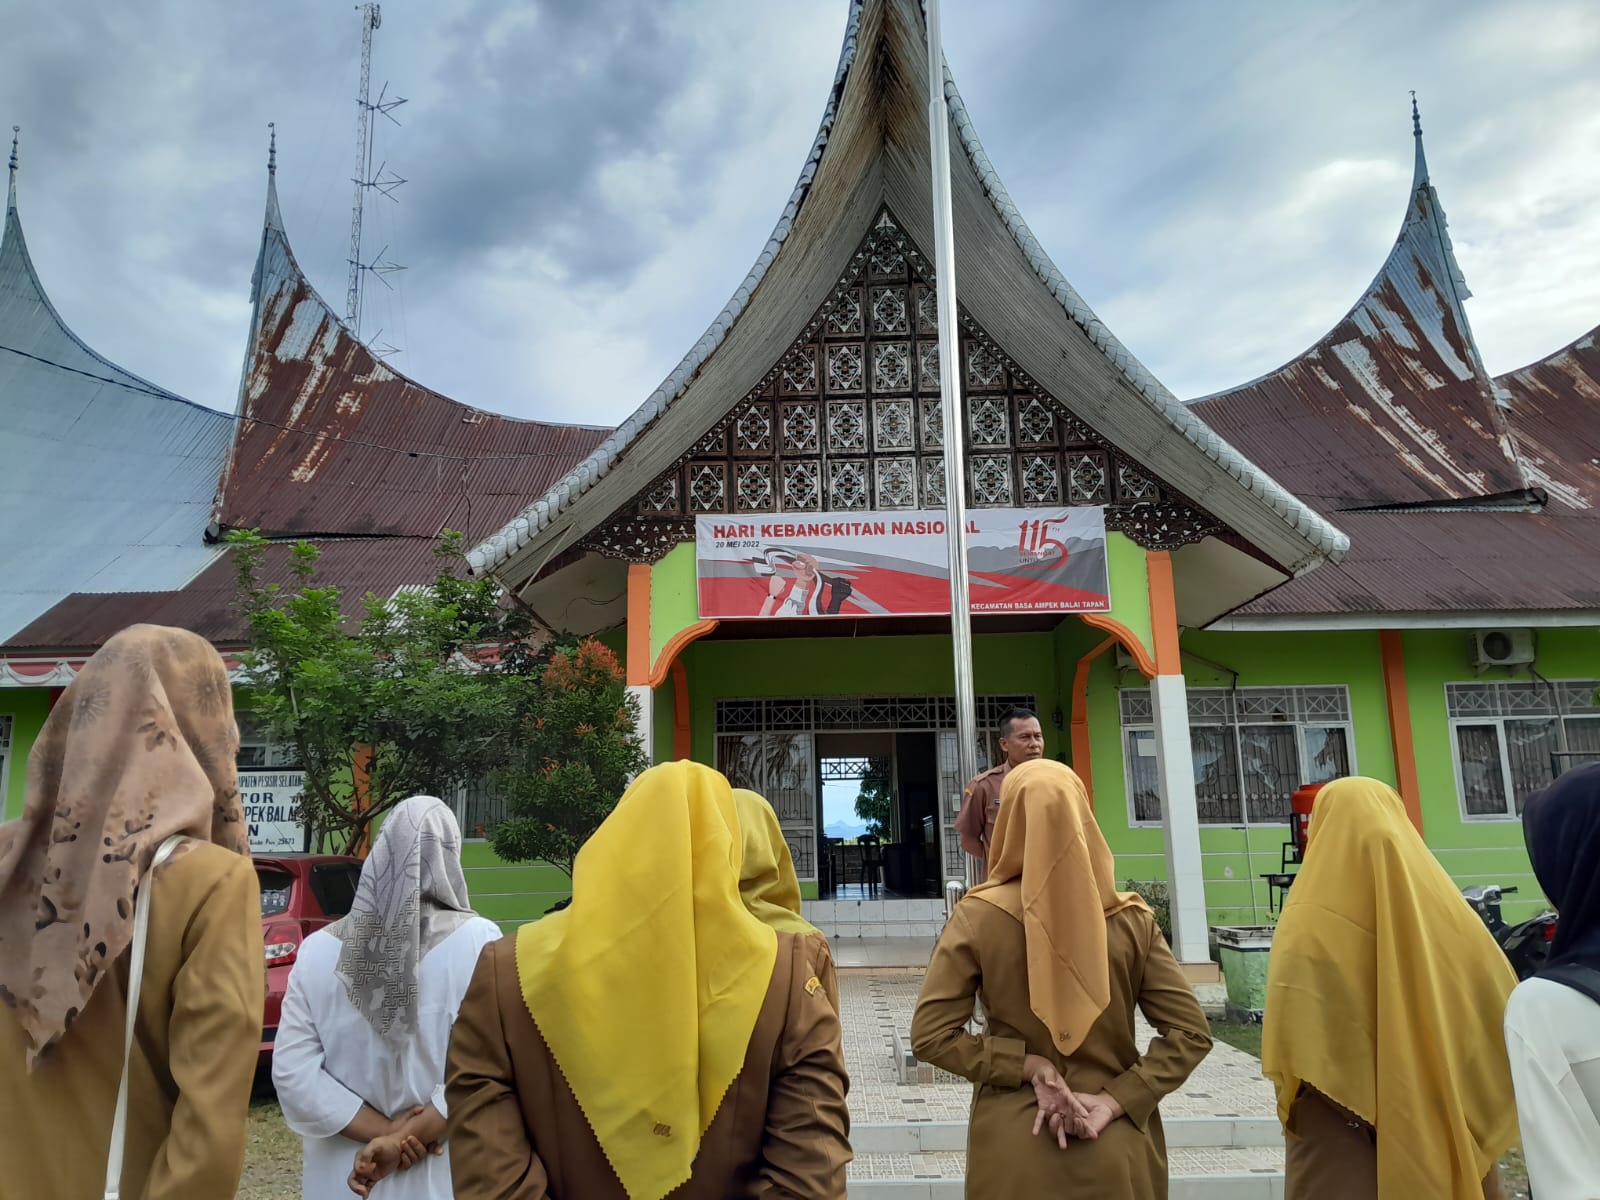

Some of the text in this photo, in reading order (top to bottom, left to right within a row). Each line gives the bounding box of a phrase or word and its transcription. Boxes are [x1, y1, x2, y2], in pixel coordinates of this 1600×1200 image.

[713, 519, 980, 538] HARI KEBANGKITAN NASIOL
[726, 540, 741, 548] MEI
[1018, 514, 1069, 569] 115
[1082, 600, 1105, 608] TAPAN
